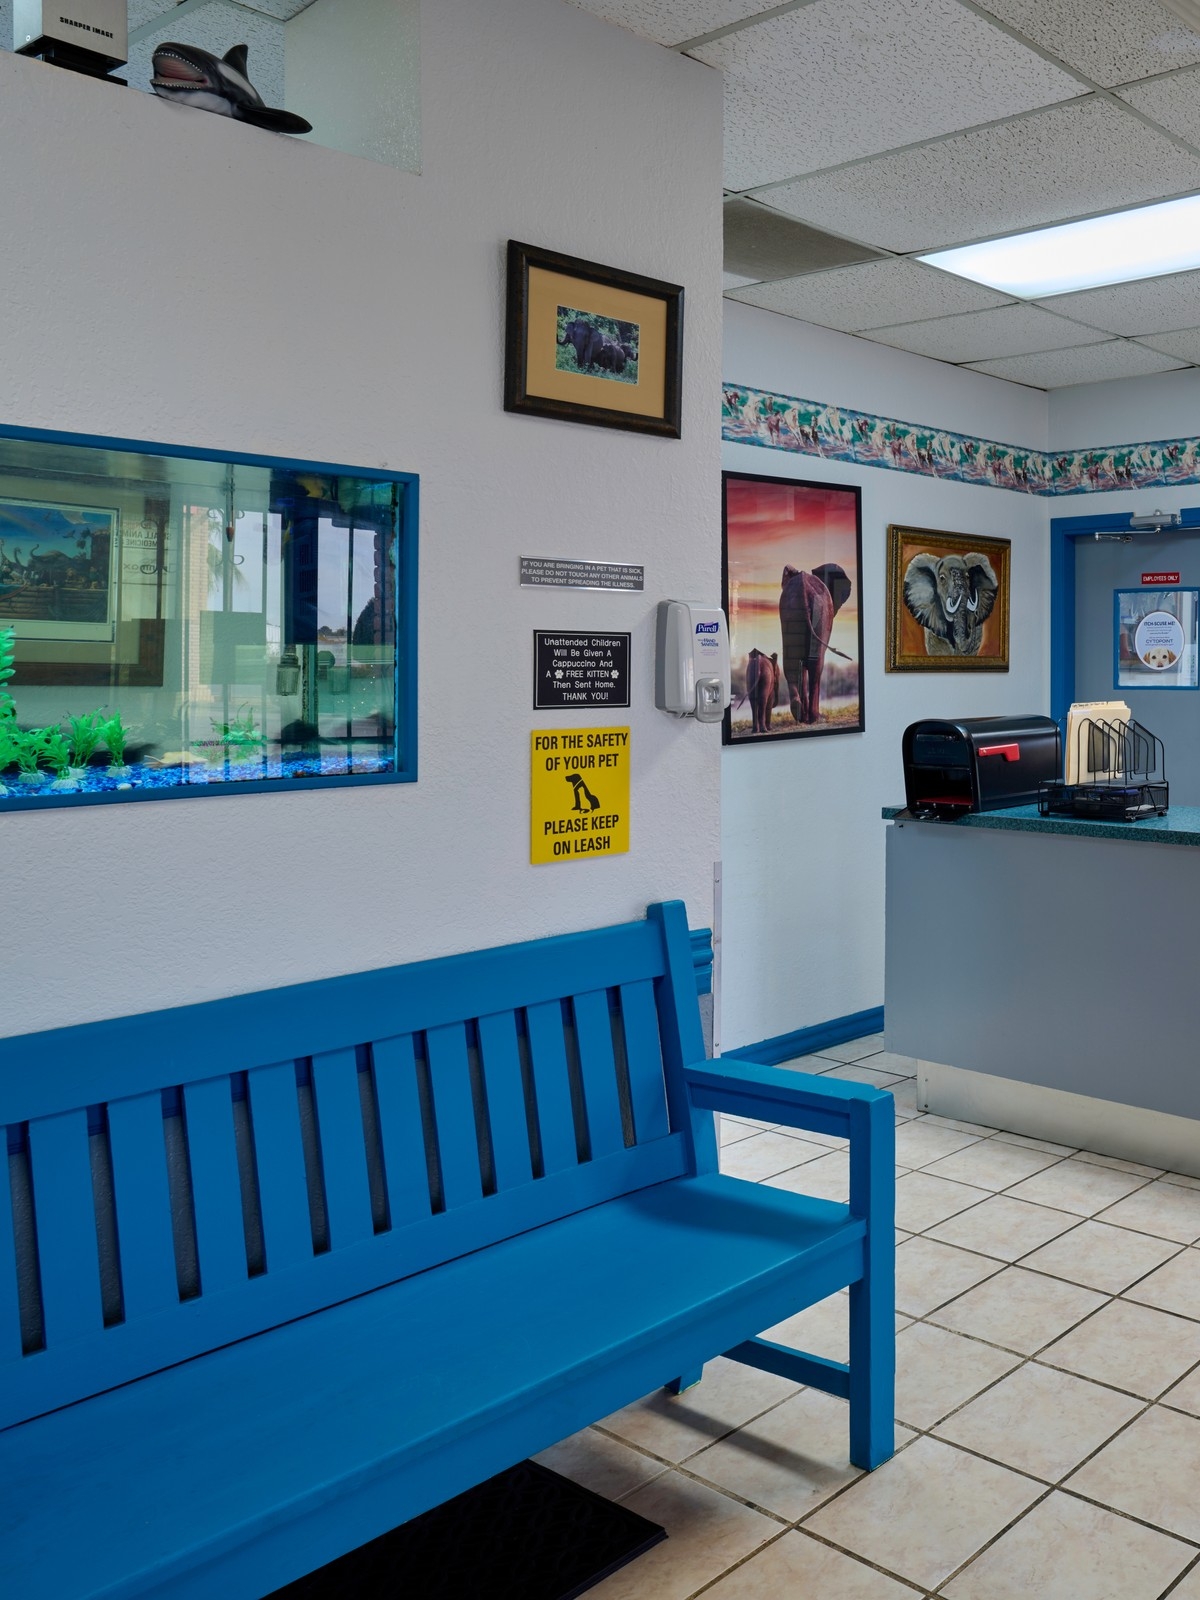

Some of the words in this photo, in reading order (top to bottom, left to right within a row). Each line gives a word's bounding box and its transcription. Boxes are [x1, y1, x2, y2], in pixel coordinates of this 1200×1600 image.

[60, 16, 90, 31] SHARPER
[92, 27, 114, 38] IMAGE
[544, 638, 588, 647] Unattended
[592, 638, 620, 647] Children
[554, 649, 567, 657] Will
[583, 649, 603, 657] Given
[552, 659, 596, 669] Cappuccino
[599, 659, 613, 668] And
[546, 670, 551, 678] A
[566, 670, 583, 678] FREE
[586, 670, 610, 678] KITTEN
[552, 680, 571, 688] Then
[574, 680, 591, 688] Sent
[594, 680, 616, 689] Home.
[562, 692, 588, 700] THANK
[591, 692, 608, 700] YOU!
[536, 736, 558, 750] FOR
[562, 735, 583, 750] THE
[586, 732, 628, 748] SAFETY
[546, 758, 560, 771] OF
[564, 756, 594, 770] YOUR
[598, 754, 619, 768] PET
[544, 818, 588, 836] PLEASE
[592, 815, 619, 830] KEEP
[554, 841, 570, 856] ON
[574, 836, 610, 853] LEASH
